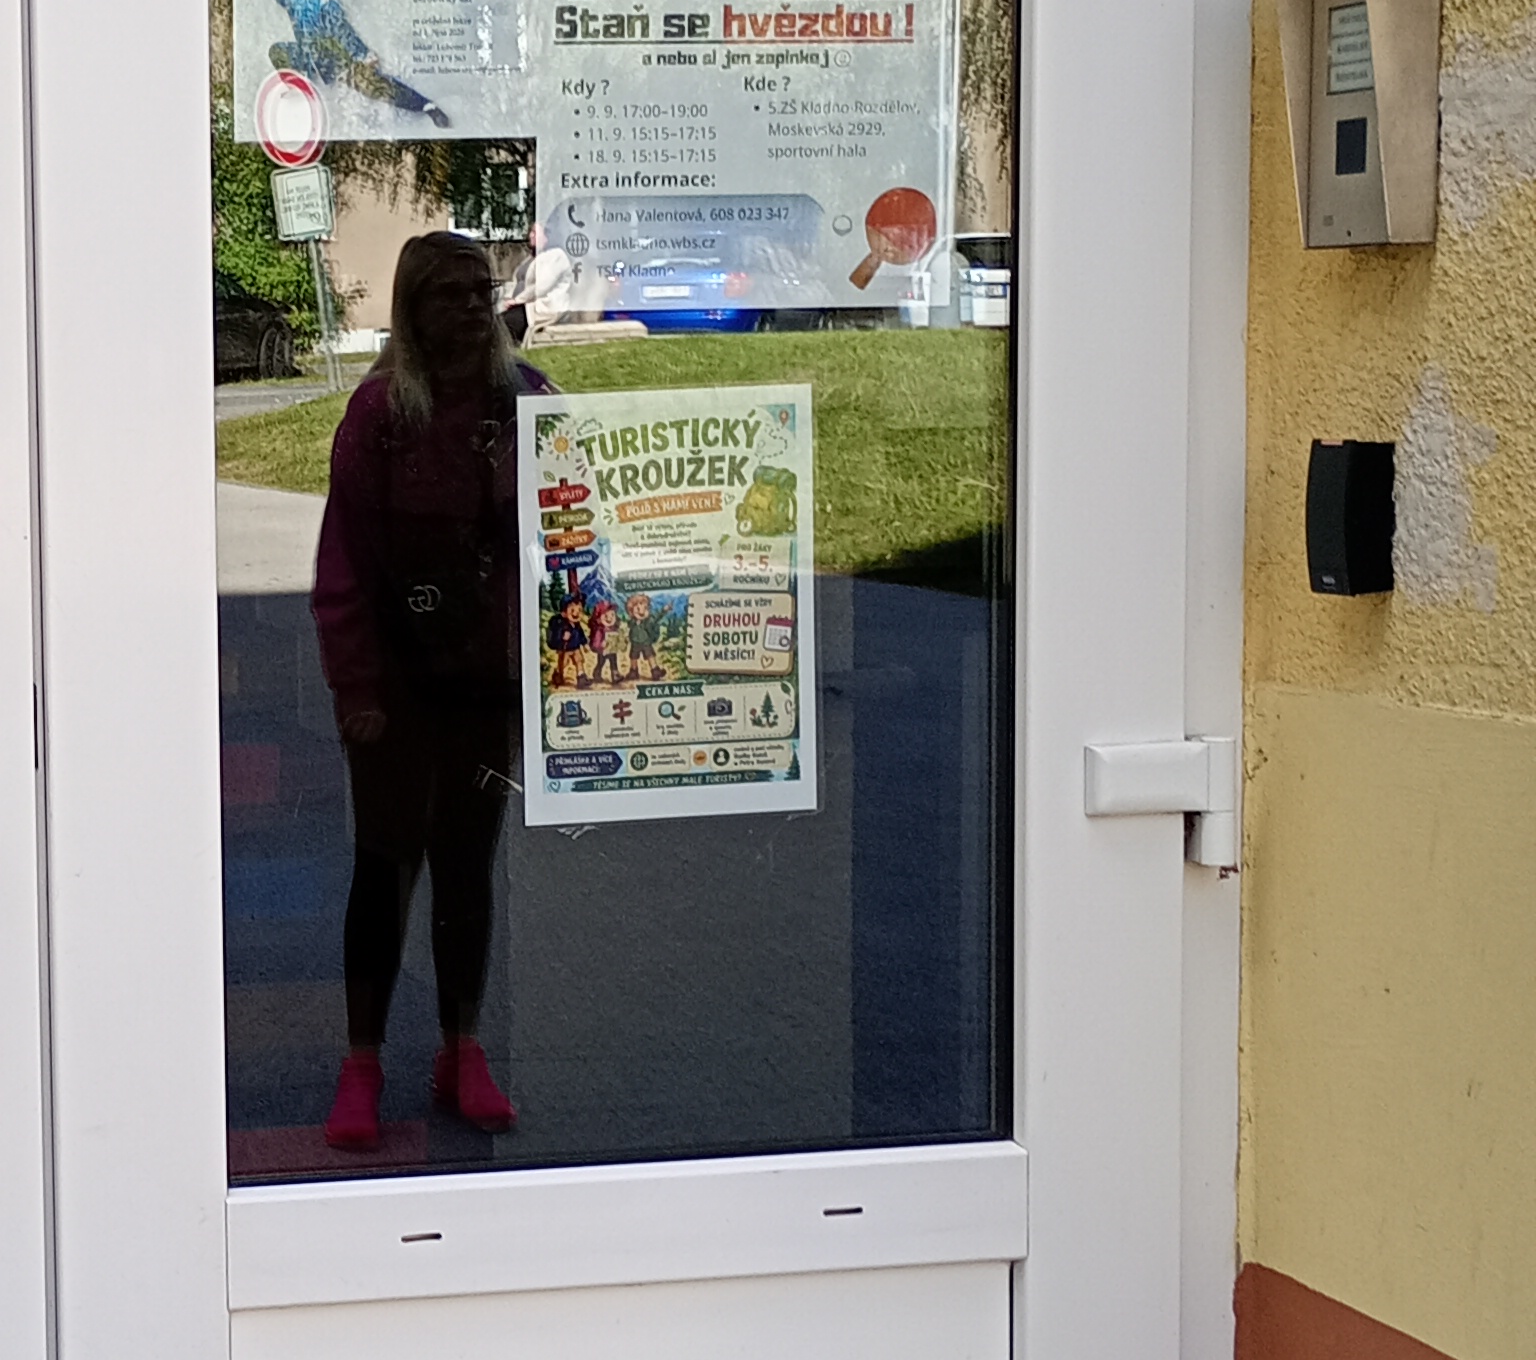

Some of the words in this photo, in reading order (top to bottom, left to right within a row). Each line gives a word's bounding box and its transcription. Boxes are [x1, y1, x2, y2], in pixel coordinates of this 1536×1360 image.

[554, 3, 651, 39] Staň
[663, 13, 711, 39] se
[723, 3, 892, 39] hvězdou
[642, 53, 652, 66] a
[656, 51, 697, 67] nebo
[702, 50, 717, 67] si
[722, 50, 752, 69] jen
[561, 80, 596, 99] Kdy
[601, 80, 610, 95] ?
[744, 77, 776, 92] Kde
[782, 77, 791, 91] ?
[587, 105, 600, 118] 9.
[605, 105, 617, 118] 9.
[768, 99, 797, 115] 5.ZŠ
[588, 128, 609, 142] 11.
[613, 128, 626, 142] 9.
[768, 122, 844, 137] Moskevská
[588, 150, 609, 164] 18.
[613, 150, 626, 164] 9.
[768, 145, 833, 161] sportovní
[837, 145, 867, 158] hala
[560, 173, 610, 189] Extra
[615, 171, 716, 188] informace:
[636, 208, 706, 223] Valentová,
[710, 207, 734, 221] 608
[738, 207, 762, 220] 023
[766, 207, 789, 220] 347
[629, 265, 676, 278] Kladno
[576, 409, 761, 467] TURISTICKÝ
[595, 449, 749, 502] KROUŽEK
[703, 612, 761, 628] DRUHOU
[703, 630, 759, 646] SOBOTU
[703, 650, 711, 661] V
